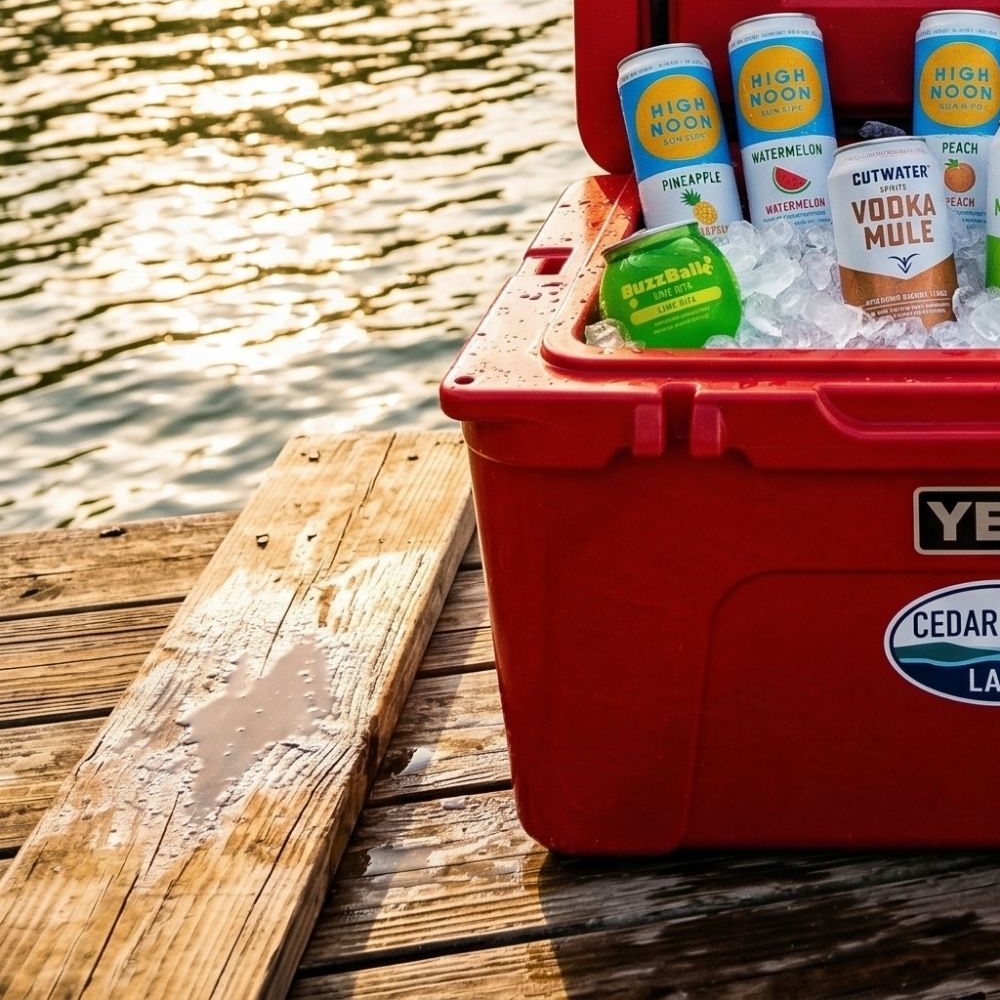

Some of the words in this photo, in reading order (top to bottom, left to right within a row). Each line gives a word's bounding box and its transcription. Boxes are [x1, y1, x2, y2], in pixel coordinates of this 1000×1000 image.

[751, 68, 805, 88] HIGH
[935, 67, 989, 82] HIGH
[750, 87, 811, 108] NOON
[930, 85, 992, 100] NOON
[651, 97, 706, 119] HIGH
[650, 115, 712, 138] NOON
[752, 144, 823, 164] WATERMELON
[942, 142, 978, 154] PEACH
[662, 171, 722, 191] PINEAPPLE
[852, 165, 928, 186] CUTWATER
[880, 184, 907, 193] SPIRITS
[765, 198, 826, 215] WATERMELON
[851, 193, 936, 224] VODKA
[864, 220, 934, 250] MULE
[913, 609, 998, 638] CEDAR
